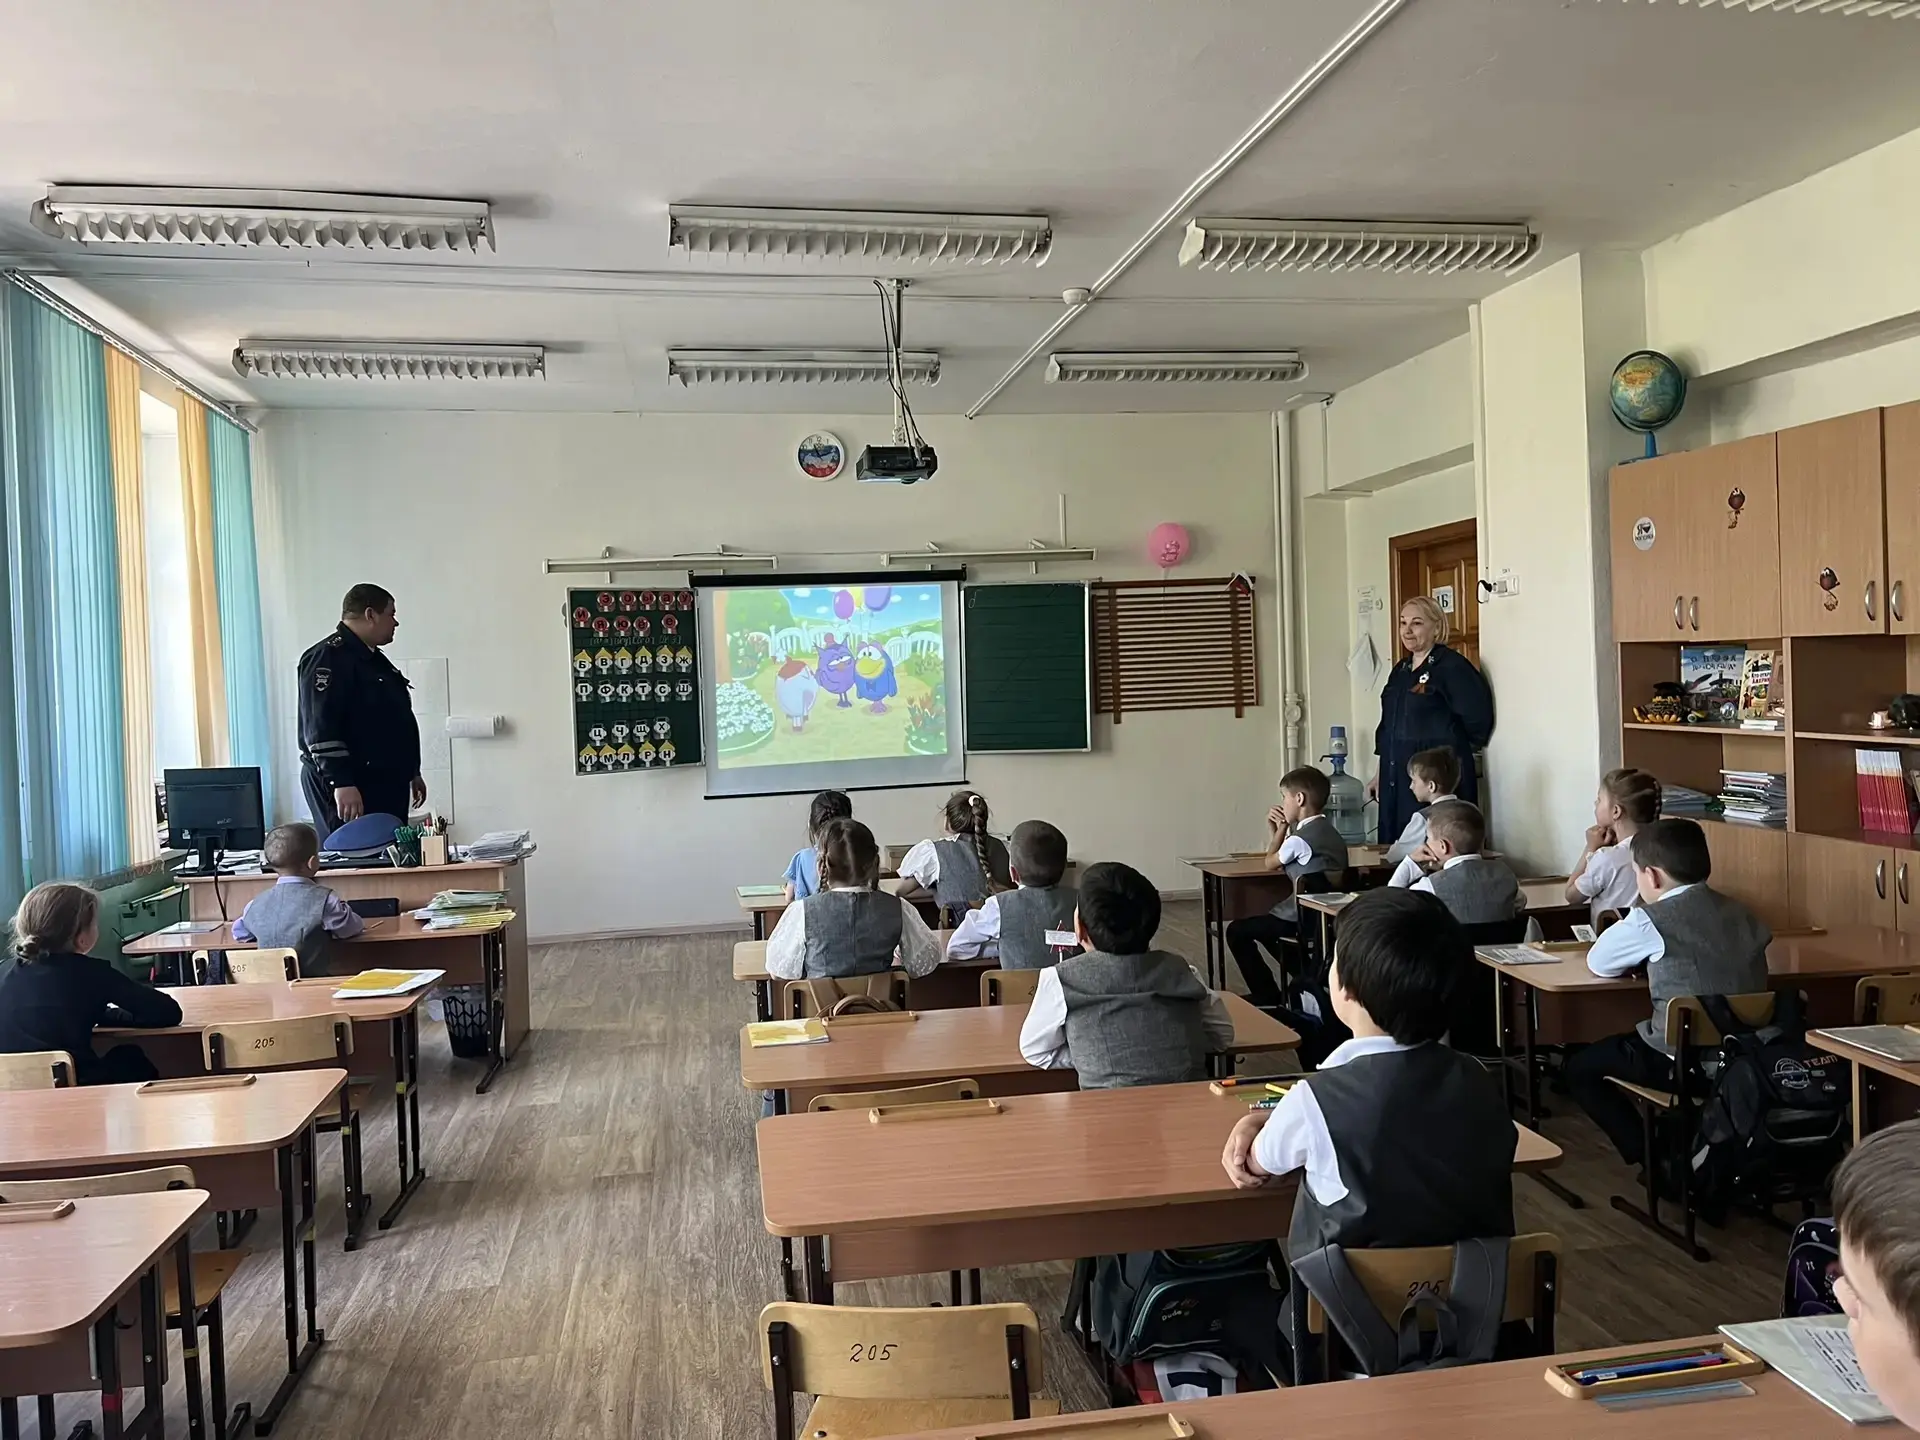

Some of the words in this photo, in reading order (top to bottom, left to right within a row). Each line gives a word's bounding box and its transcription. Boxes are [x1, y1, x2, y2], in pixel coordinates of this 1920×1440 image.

[578, 660, 587, 669] Б
[231, 964, 247, 974] 205
[254, 1036, 275, 1050] 205
[1803, 1054, 1838, 1068] TEAM
[849, 1343, 898, 1363] 205
